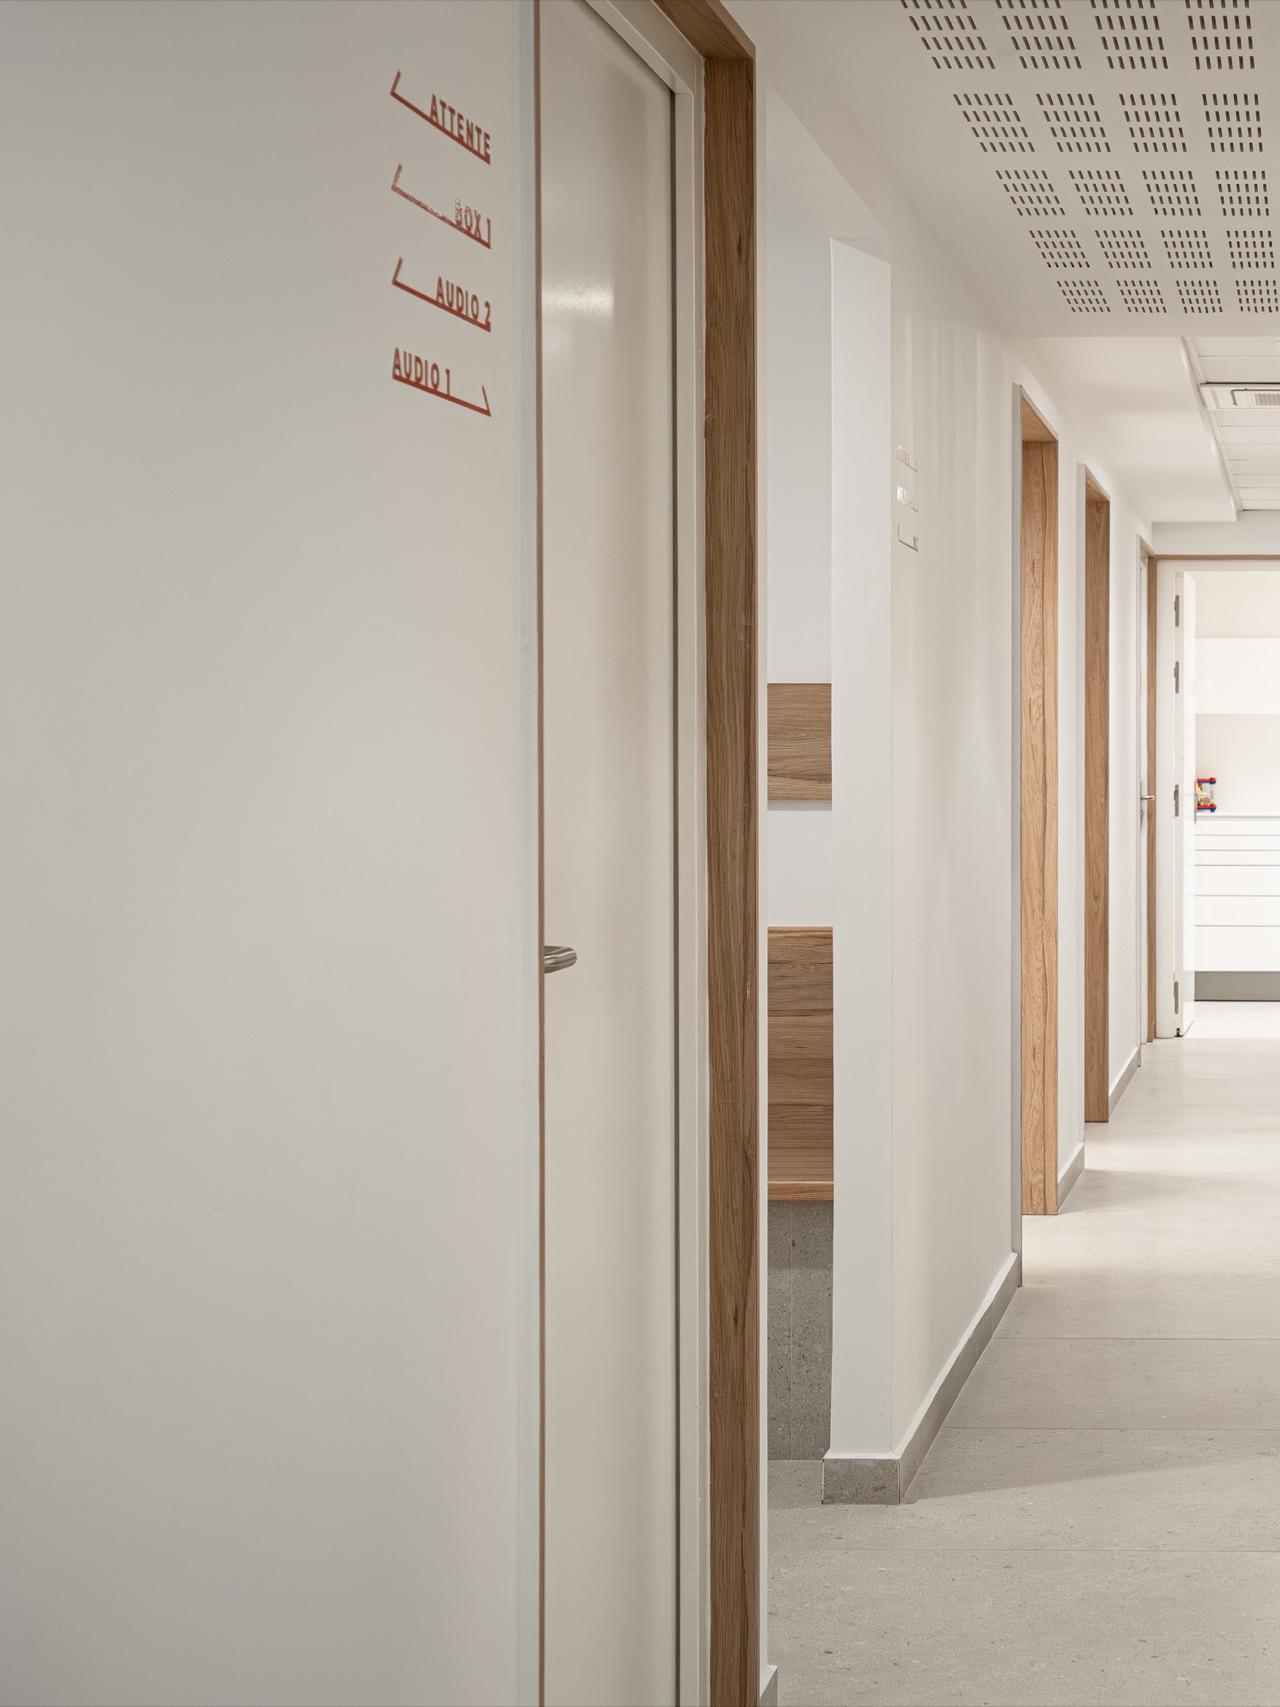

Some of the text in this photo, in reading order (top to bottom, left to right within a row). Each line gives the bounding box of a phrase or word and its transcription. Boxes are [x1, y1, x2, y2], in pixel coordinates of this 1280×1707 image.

[430, 93, 491, 161] ATTENTE
[454, 198, 491, 247] BOX 1
[436, 275, 491, 330] AUDIO 2
[392, 346, 451, 397] AUDIO 1
